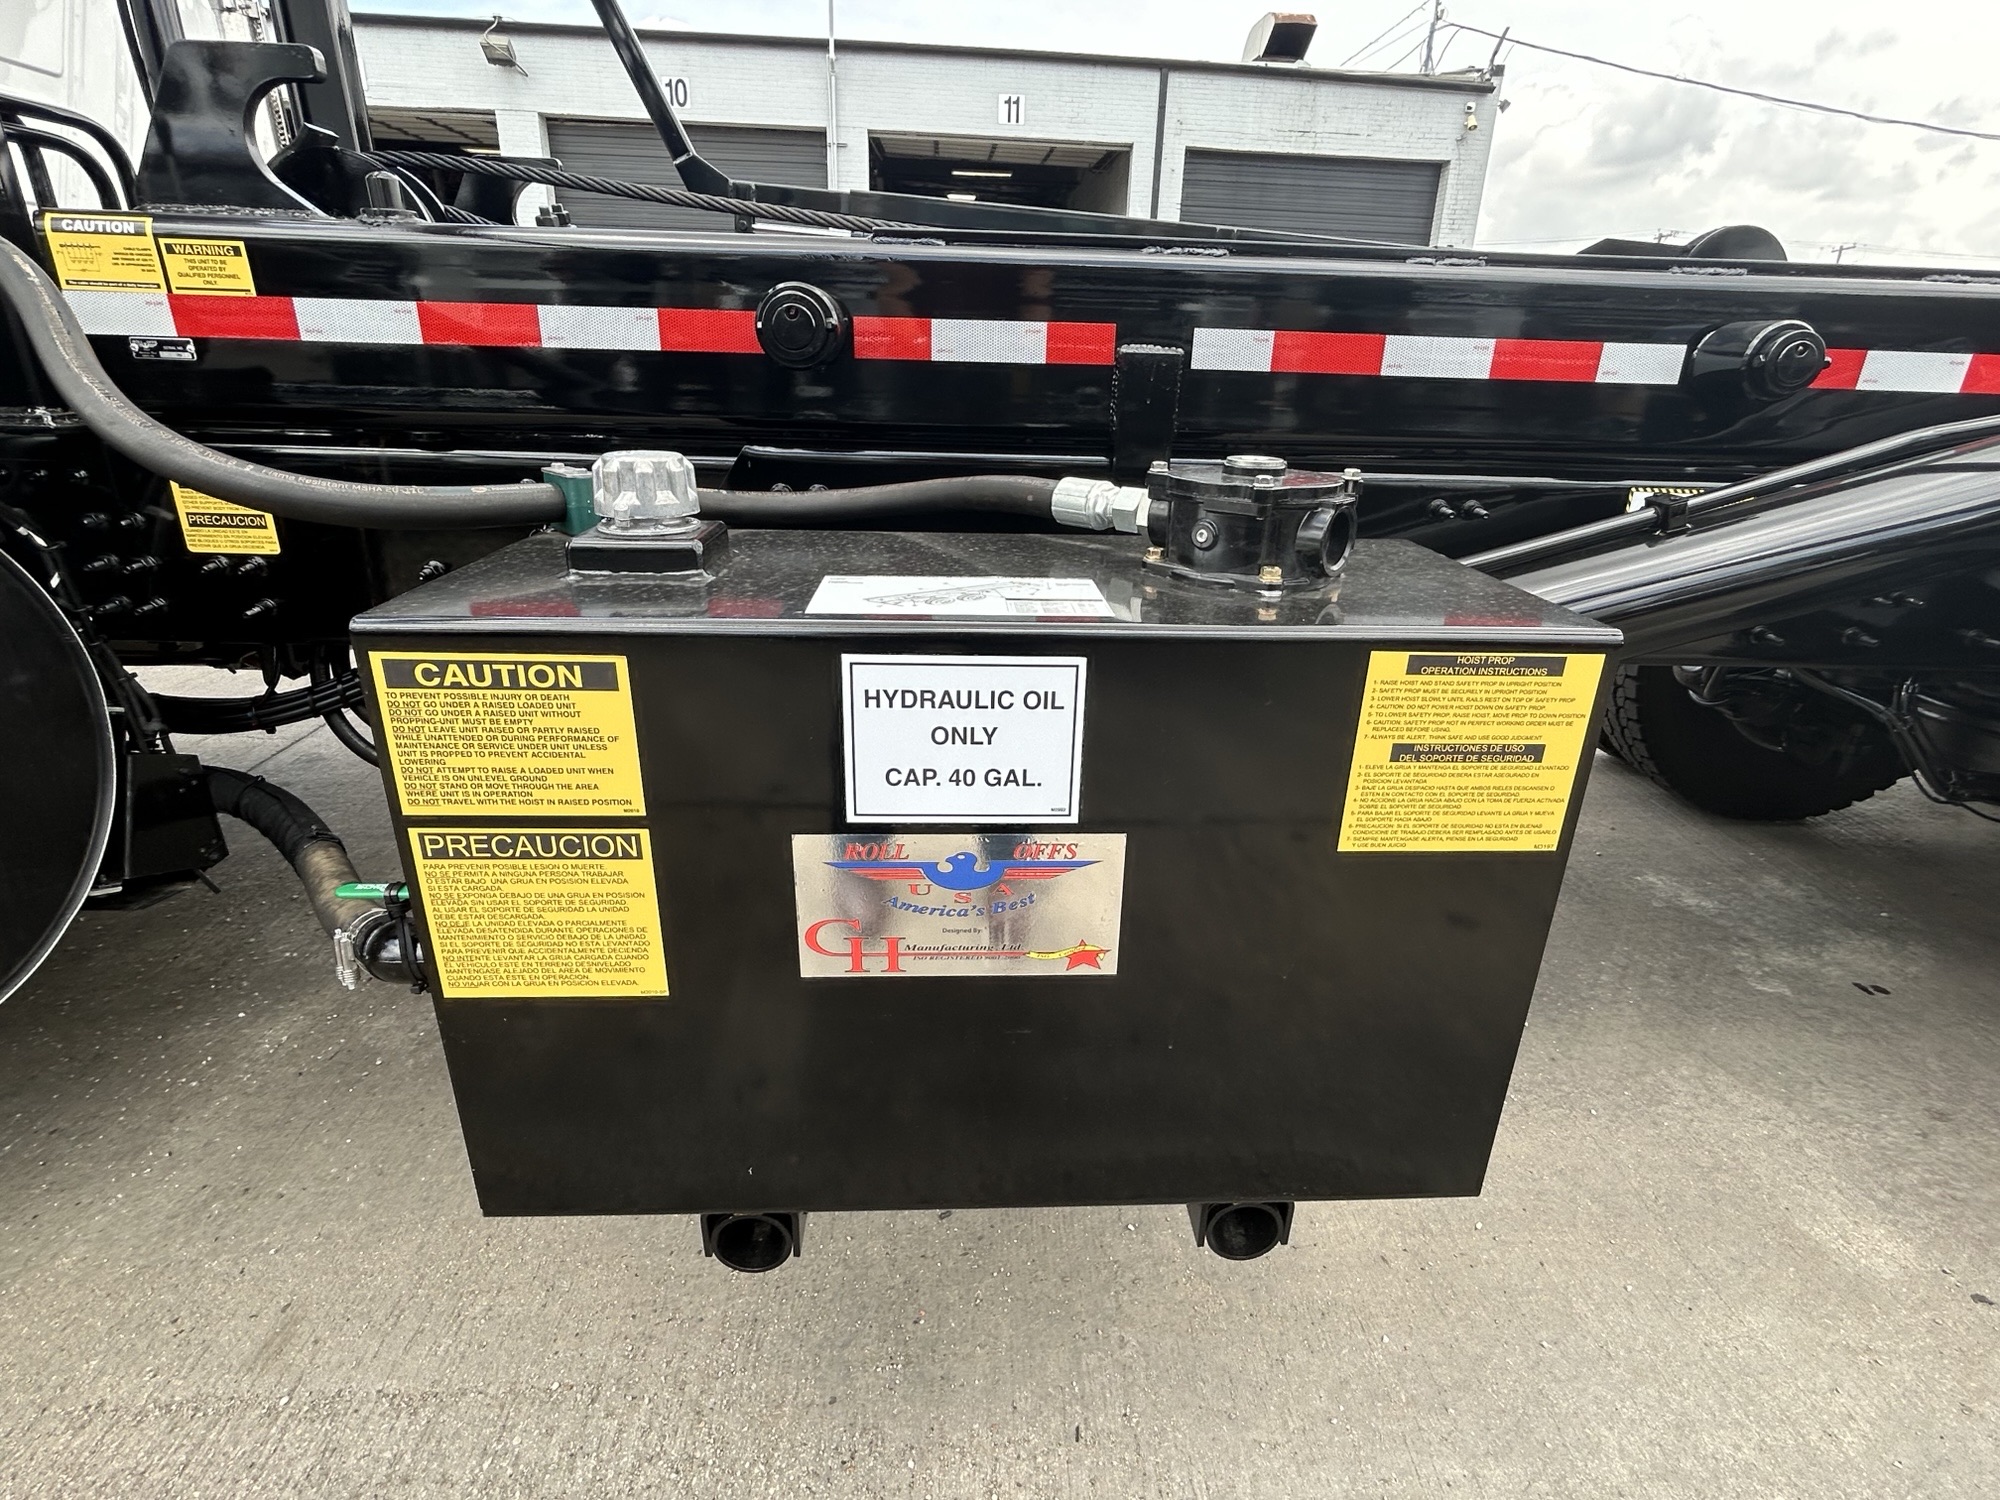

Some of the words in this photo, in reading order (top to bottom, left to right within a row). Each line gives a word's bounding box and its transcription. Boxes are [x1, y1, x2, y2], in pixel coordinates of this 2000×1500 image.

[665, 78, 687, 107] 10
[1004, 95, 1020, 123] 11
[61, 219, 135, 234] CAUTION
[171, 243, 235, 256] WARNING
[297, 476, 348, 490] Resistant
[352, 484, 382, 493] MSHA
[188, 514, 267, 527] PRECAUCION
[1456, 656, 1487, 664] HOIST
[1487, 656, 1515, 665] PROP
[414, 662, 583, 688] CAUTION
[1420, 666, 1476, 675] OPERATION
[1477, 667, 1548, 677] INSTRUCTIONS
[384, 691, 397, 699] TO
[399, 691, 441, 699] PREVENT
[443, 692, 488, 700] POSSIBLE
[490, 693, 522, 701] INJURY
[524, 693, 538, 701] OR
[539, 693, 570, 701] DEATH
[864, 689, 1015, 710] HYDRAULIC
[1023, 690, 1065, 710] OIL
[386, 700, 400, 708] DO
[402, 700, 421, 708] NOT
[423, 700, 437, 708] GO
[481, 701, 515, 709] RAISED
[517, 701, 554, 709] LOADED
[390, 716, 459, 725] PROPPING-UNIT
[461, 717, 486, 725] MUST
[391, 725, 405, 733] DO
[407, 725, 425, 733] NOT
[427, 725, 456, 733] LEAVE
[481, 726, 515, 734] RAISED
[516, 726, 530, 734] OR
[531, 726, 564, 734] PARTLY
[393, 733, 422, 741] WHILE
[485, 734, 499, 742] OR
[500, 734, 535, 742] DURING
[930, 726, 998, 746] ONLY
[395, 741, 460, 750] MAINTENANCE
[461, 742, 475, 750] OR
[476, 742, 515, 750] SERVICE
[572, 743, 608, 751] UNLESS
[1413, 743, 1488, 752] INSTRUCTIONES
[1489, 744, 1503, 752] DE
[1504, 744, 1525, 752] USO
[430, 750, 473, 758] PROPPED
[473, 750, 486, 758] TO
[487, 750, 528, 758] PREVENT
[1399, 754, 1417, 762] DEL
[1418, 754, 1464, 762] SOPORTE
[1465, 754, 1479, 762] DE
[1480, 754, 1535, 763] SEGURIDAD
[398, 758, 446, 766] LOWERING
[885, 768, 941, 787] CAP.
[948, 768, 976, 787] 40
[984, 768, 1042, 787] GAL.
[423, 834, 638, 857] PRECAUCION
[844, 843, 910, 860] ROLL
[1013, 842, 1078, 860] OFFS
[464, 877, 486, 885] BAJO
[882, 896, 986, 918] America's
[991, 891, 1037, 915] Best
[942, 927, 972, 935] Designed
